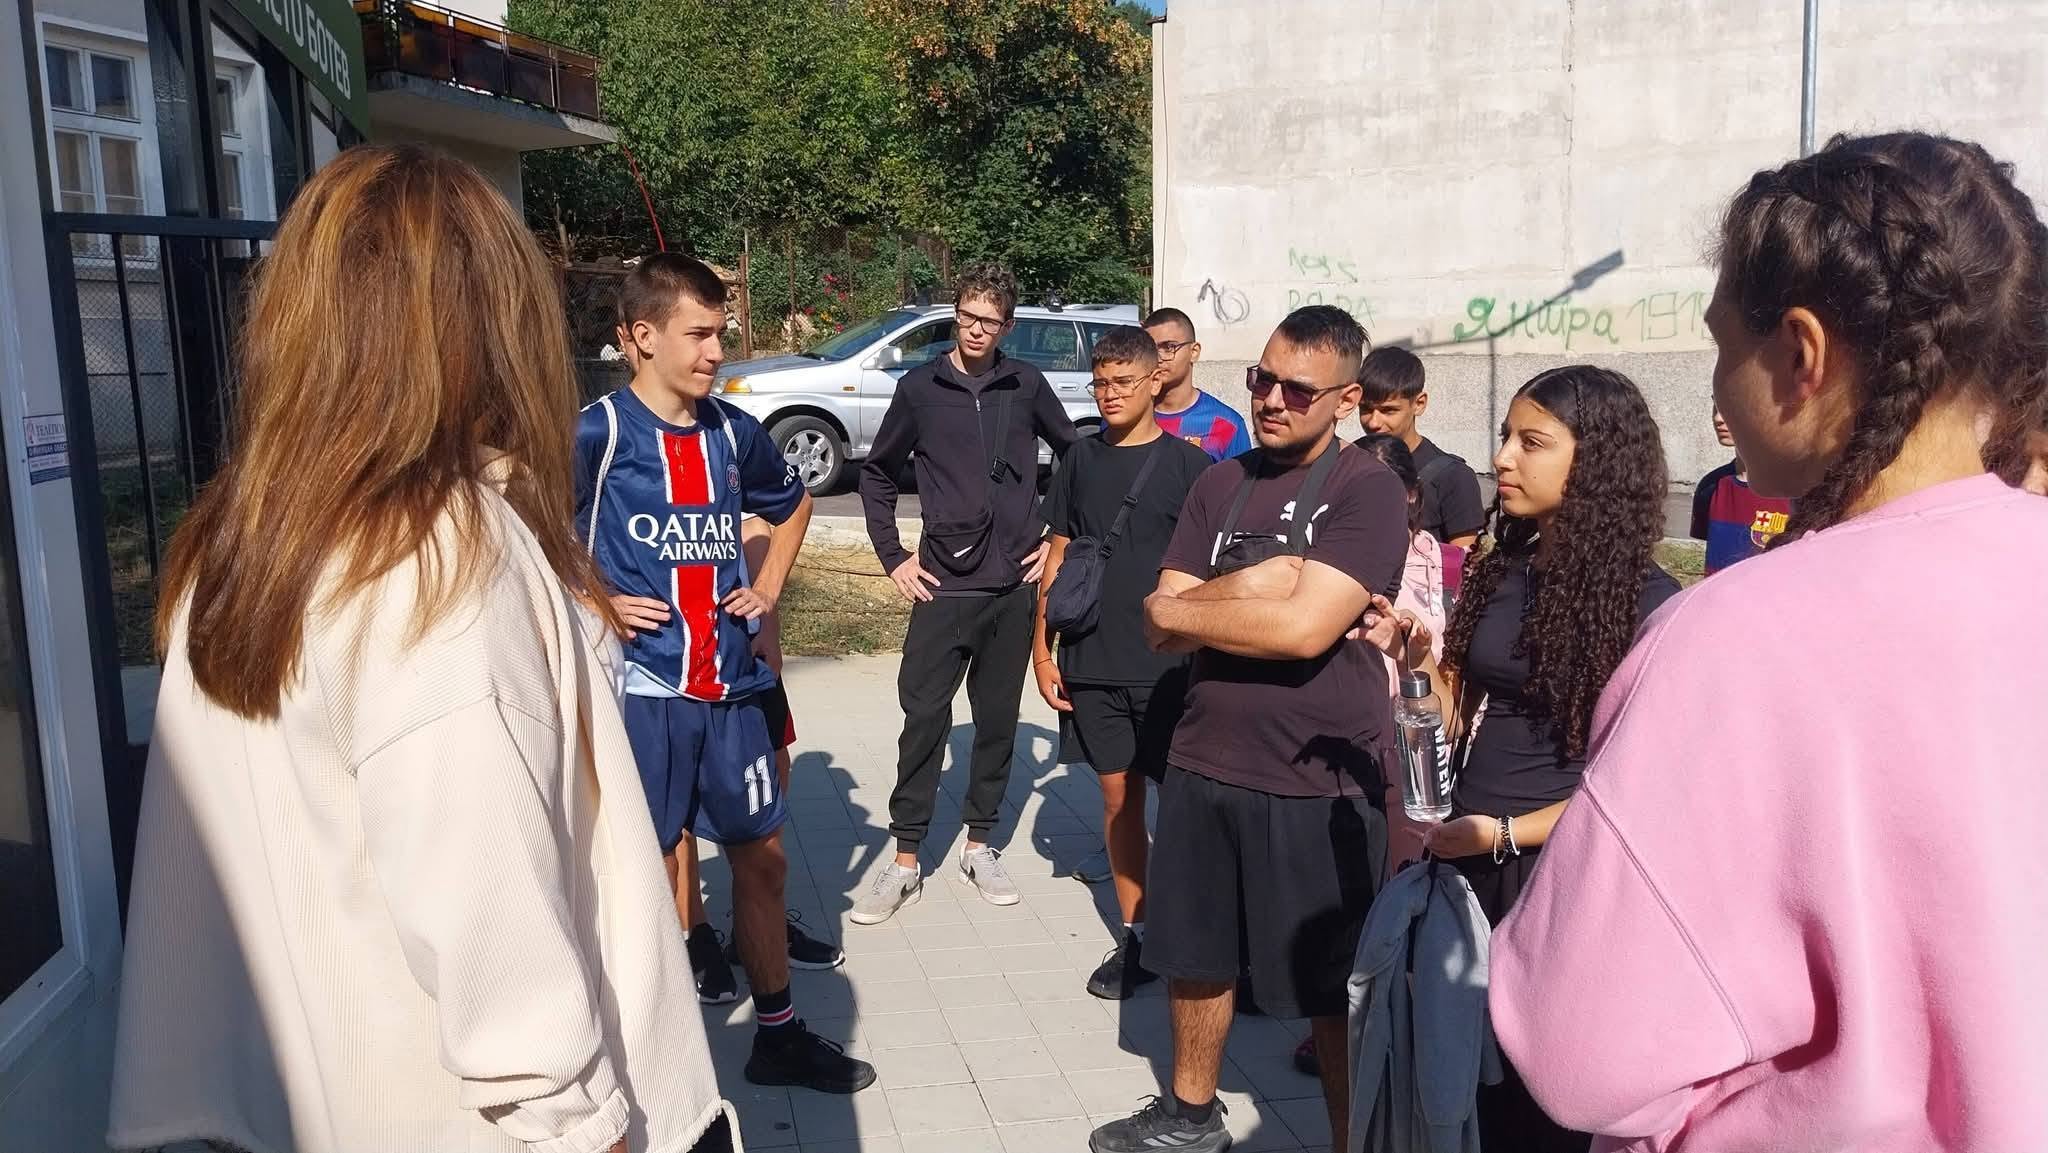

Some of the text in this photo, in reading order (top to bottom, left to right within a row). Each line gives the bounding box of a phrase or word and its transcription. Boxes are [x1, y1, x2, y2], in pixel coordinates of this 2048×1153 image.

[305, 3, 351, 100] БОТЕВ
[627, 513, 736, 548] QATAR
[658, 541, 737, 561] AIRWAYS
[744, 754, 773, 816] 11
